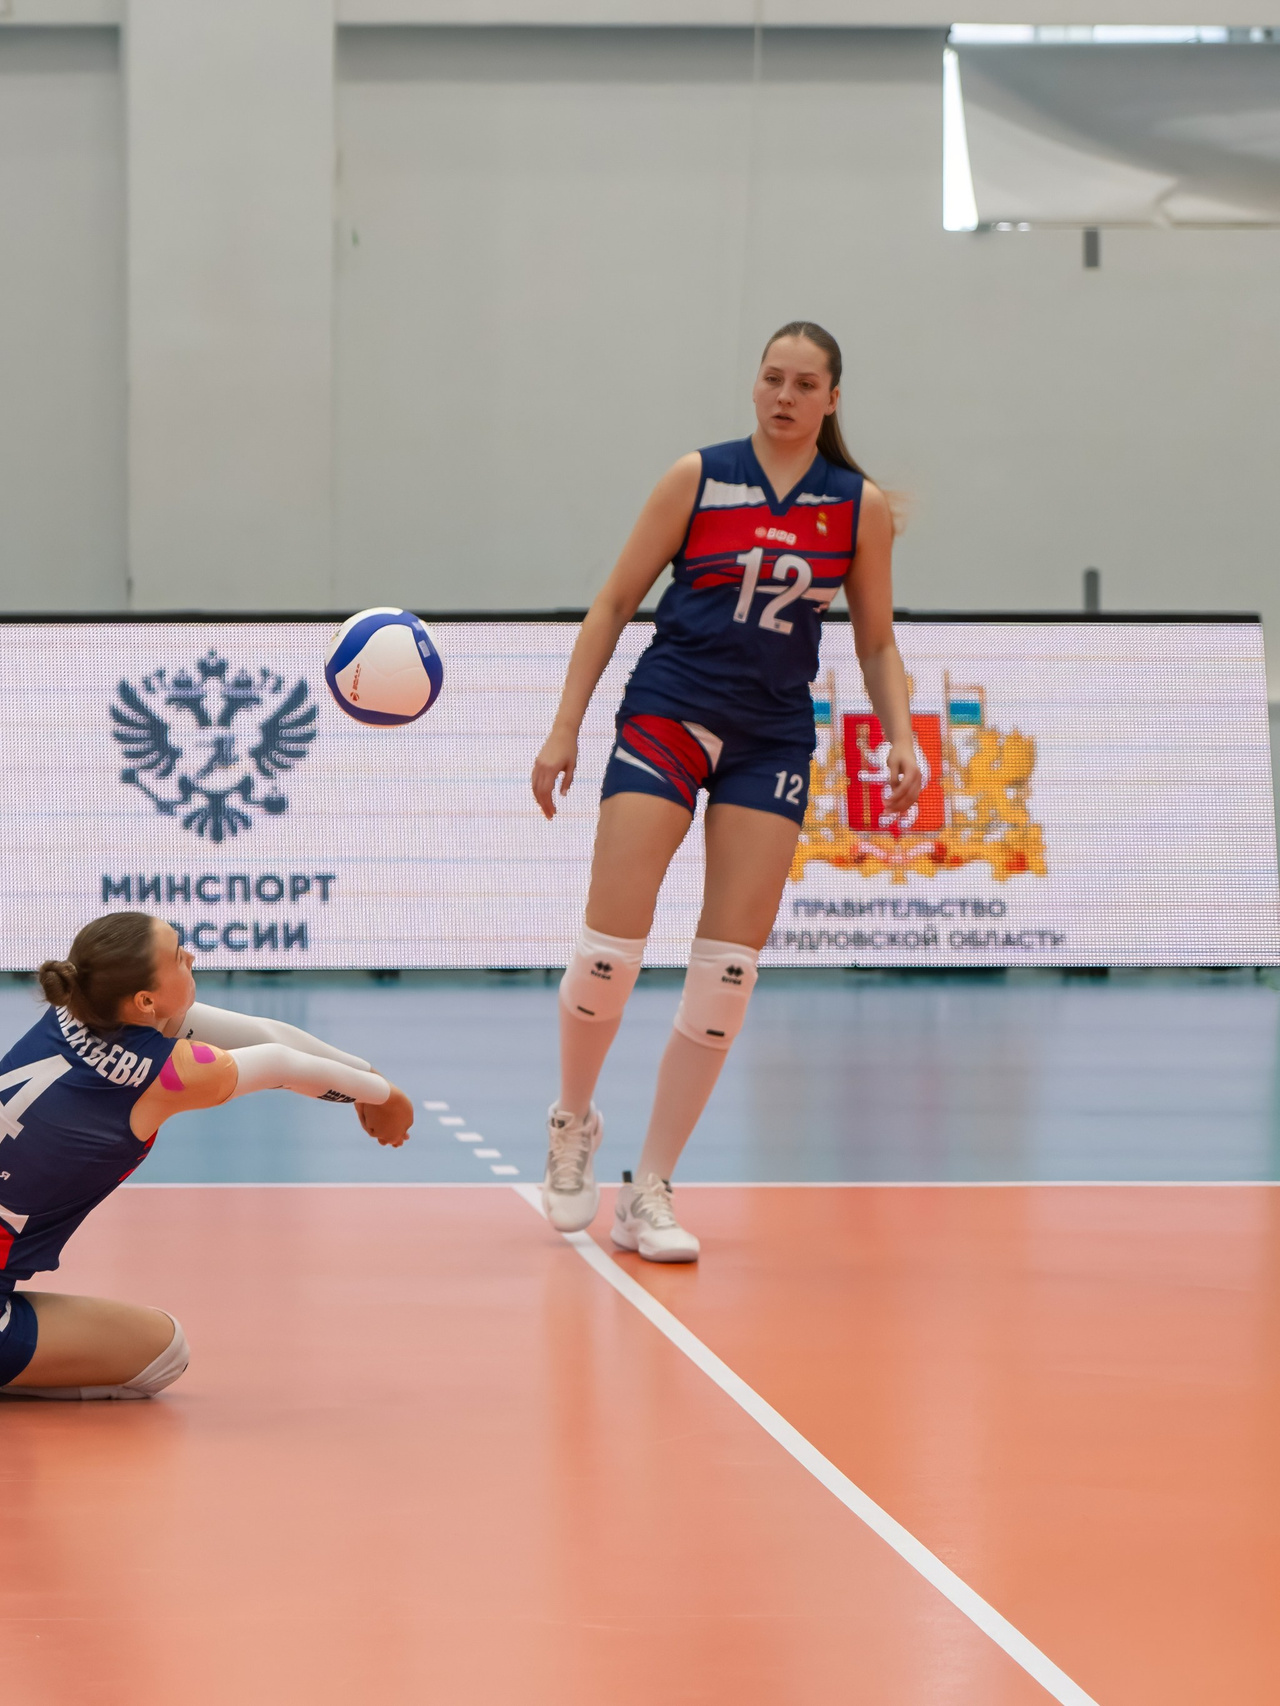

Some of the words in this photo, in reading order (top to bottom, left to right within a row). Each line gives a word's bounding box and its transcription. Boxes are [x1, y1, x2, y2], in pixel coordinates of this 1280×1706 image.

[733, 546, 813, 636] 12
[774, 770, 804, 805] 12
[101, 873, 336, 903] МИНСПОРТ
[793, 898, 1007, 918] ПРАВИТЕЛЬСТВО
